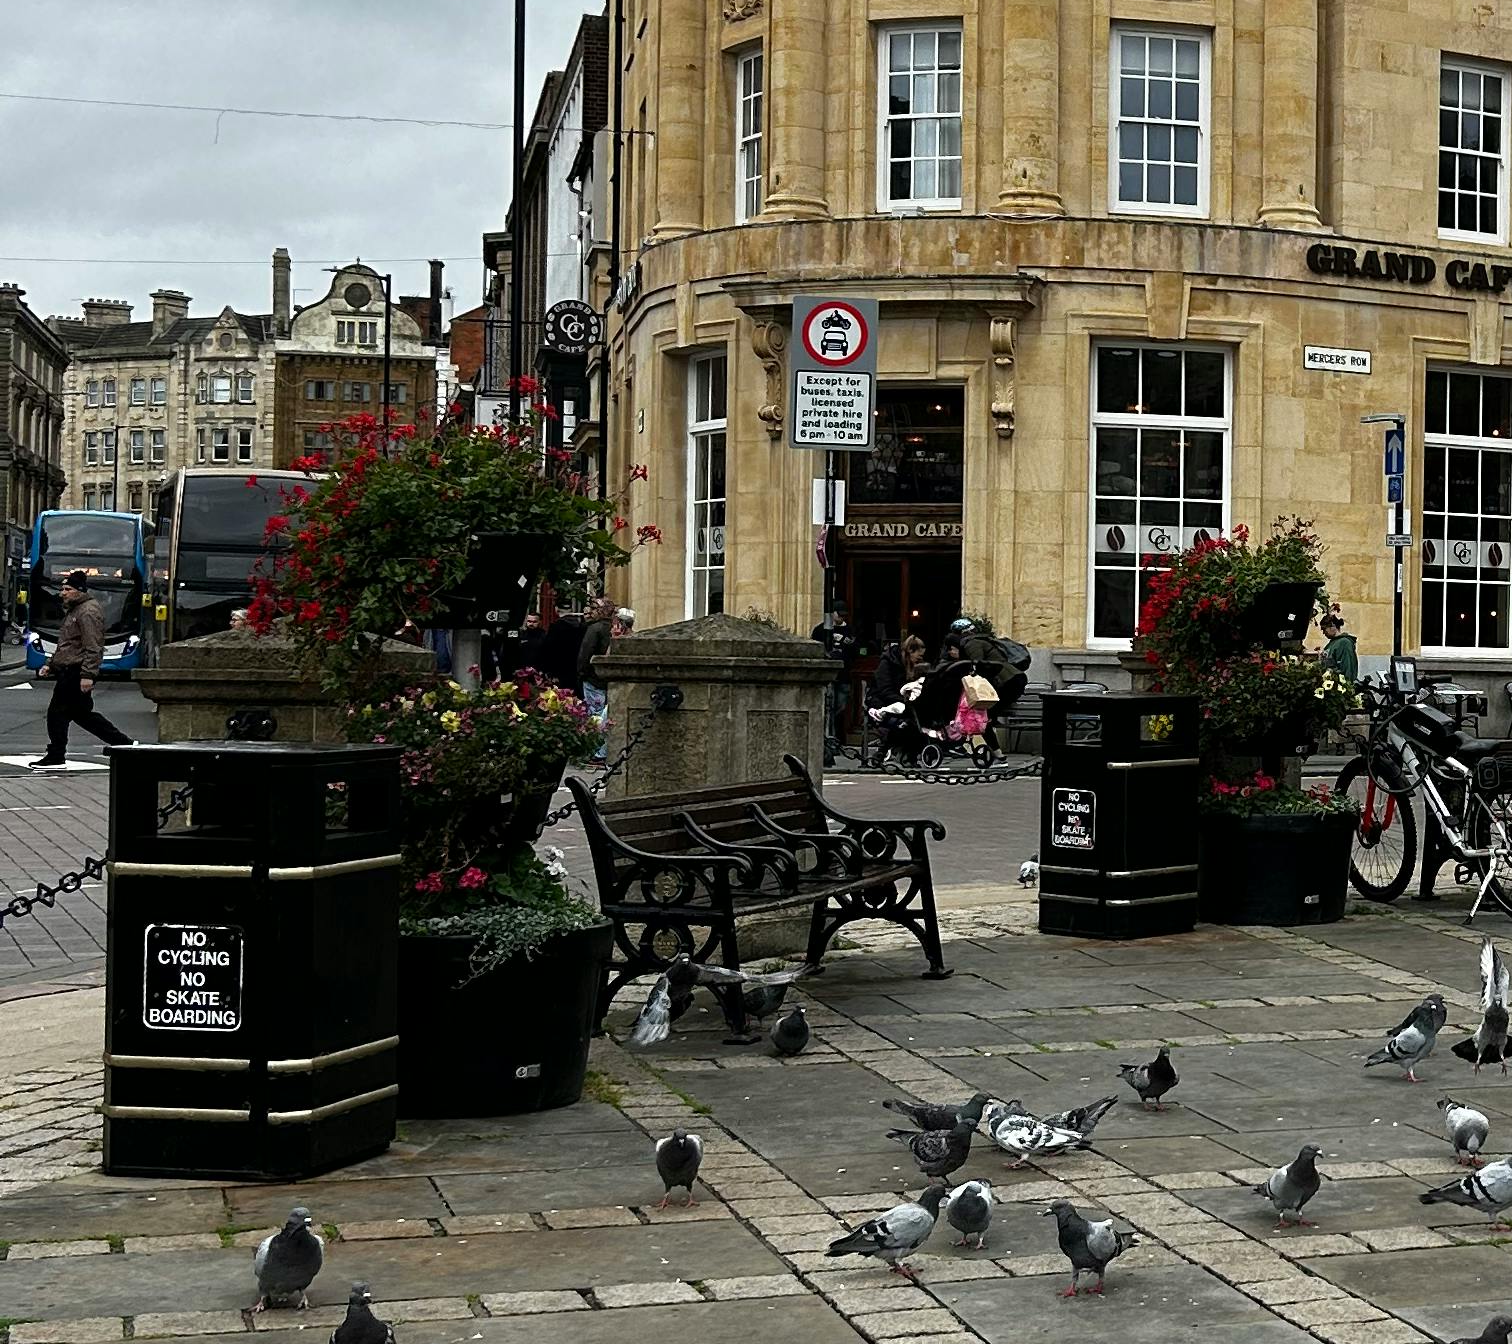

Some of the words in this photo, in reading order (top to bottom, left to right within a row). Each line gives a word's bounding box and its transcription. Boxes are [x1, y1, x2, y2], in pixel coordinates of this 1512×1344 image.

[1306, 243, 1437, 284] GRAND
[554, 302, 592, 315] GRAND
[558, 343, 586, 354] CAFE
[1307, 352, 1347, 366] MERCERS
[1350, 356, 1367, 367] ROW
[806, 375, 842, 387] Except
[846, 376, 861, 387] for
[811, 397, 855, 408] licensed
[802, 408, 839, 418] private
[842, 409, 863, 419] hire
[801, 418, 821, 428] and
[824, 419, 862, 431] loading
[809, 431, 825, 439] pm
[833, 430, 846, 439] 10
[847, 432, 863, 440] am
[844, 523, 909, 536] GRAND
[914, 523, 964, 536] CAFE
[1068, 792, 1080, 801] NO
[1058, 802, 1090, 813] CYCLING
[1061, 825, 1086, 835] SKATE
[181, 931, 207, 947] NO
[158, 949, 230, 966] CYCLING
[180, 971, 206, 987] NO
[166, 989, 220, 1006] SKATE
[149, 1008, 236, 1026] BOARDING
